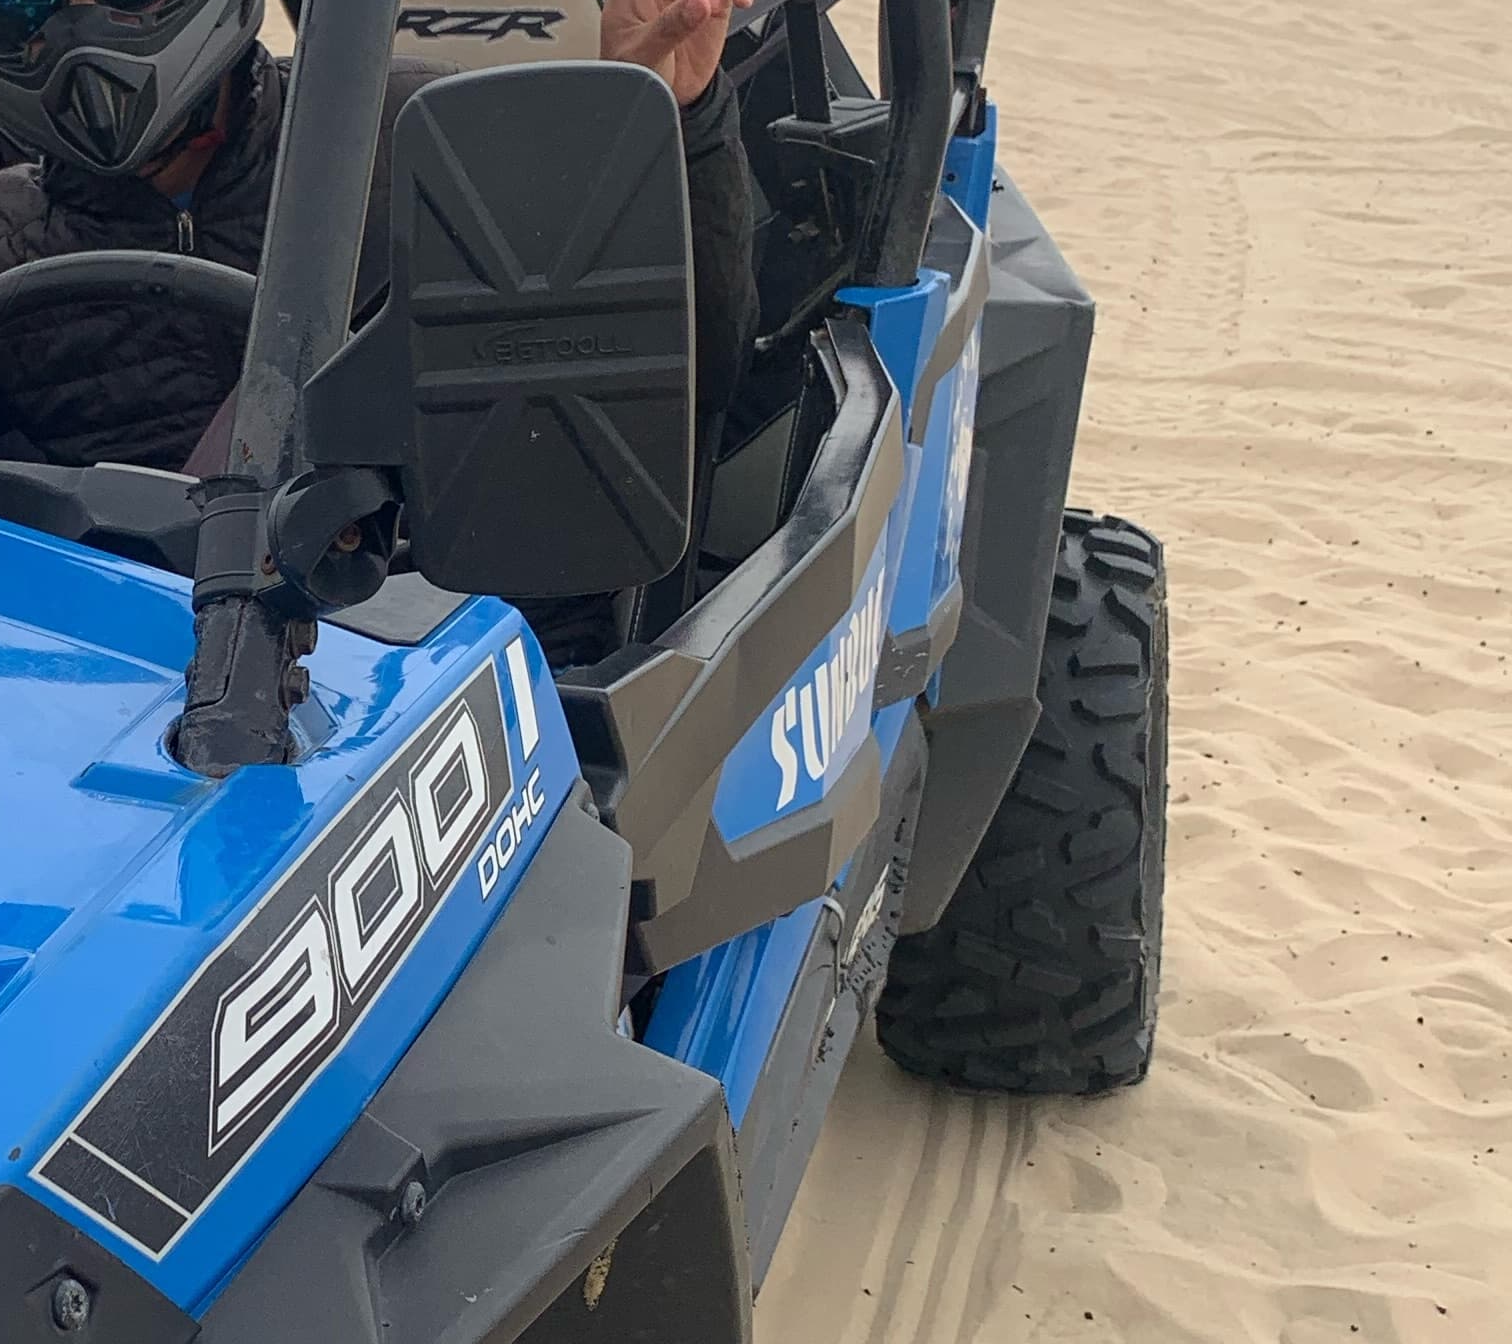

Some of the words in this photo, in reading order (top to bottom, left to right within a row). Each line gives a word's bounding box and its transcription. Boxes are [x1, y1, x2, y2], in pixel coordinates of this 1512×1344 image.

[395, 8, 567, 43] RZR
[475, 766, 545, 902] DOHC
[210, 698, 492, 1155] 900
